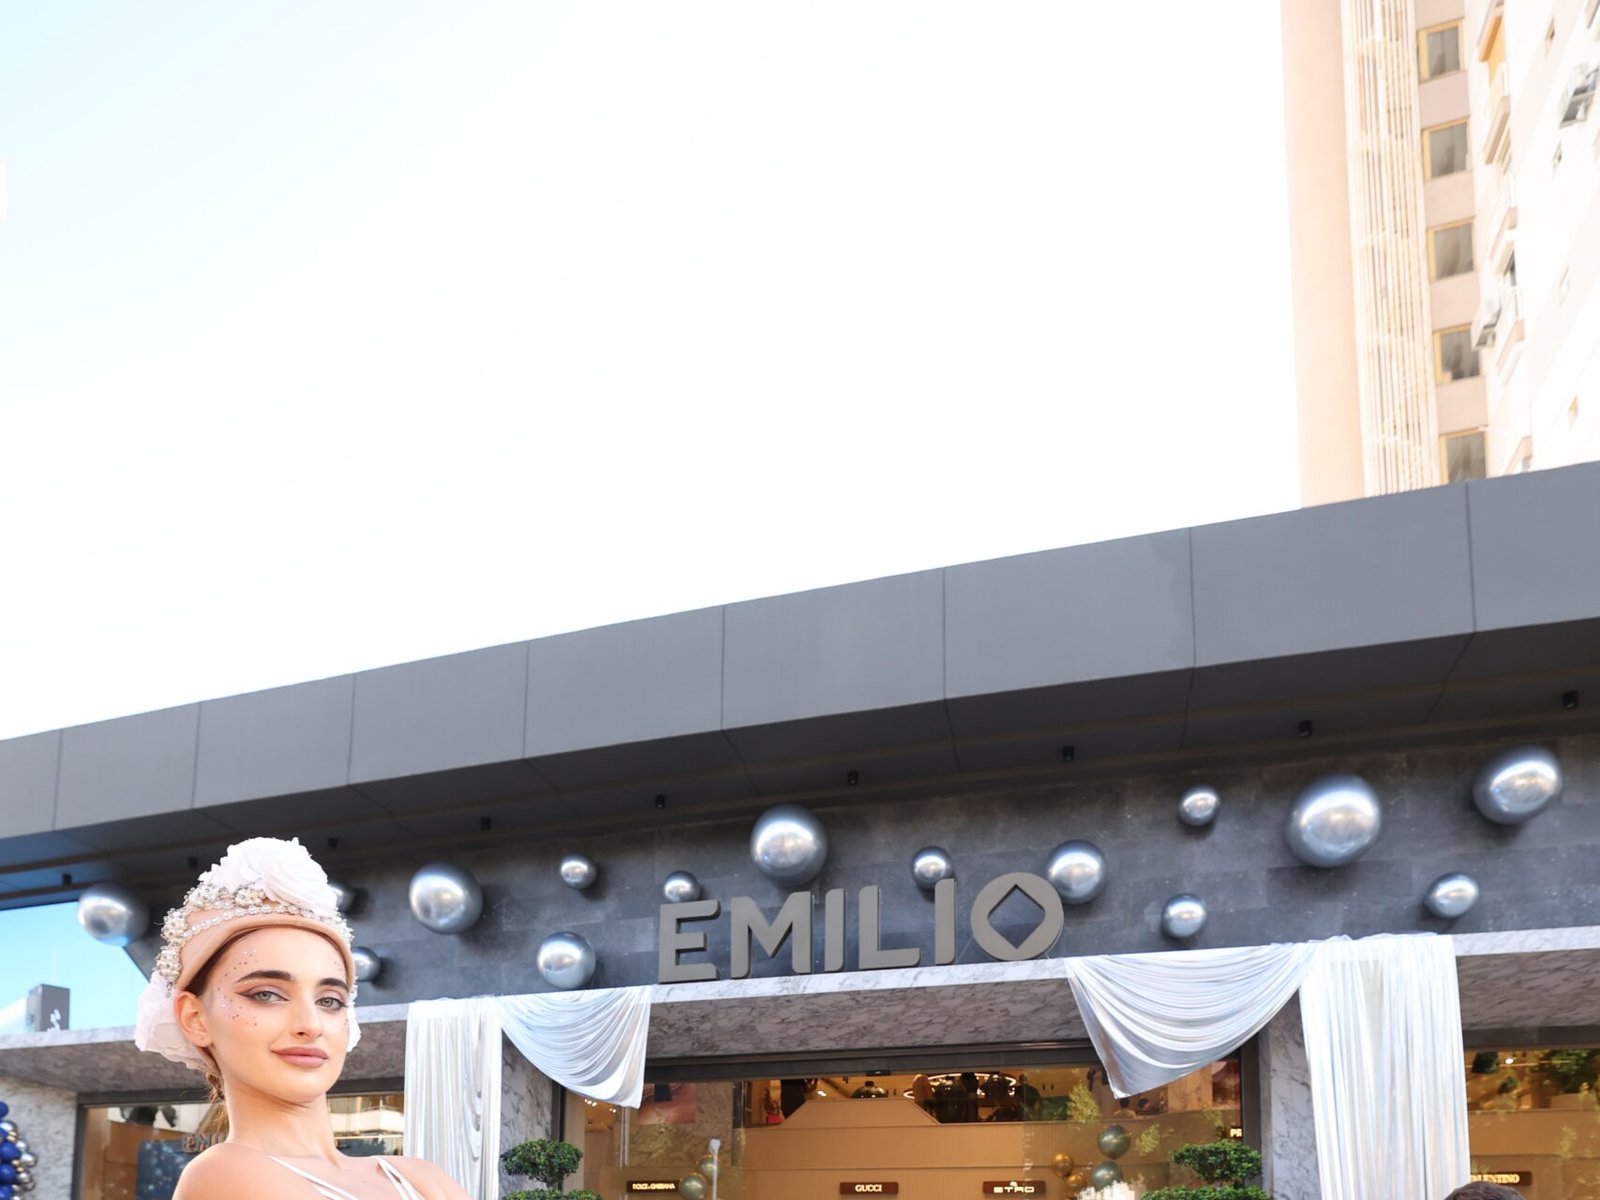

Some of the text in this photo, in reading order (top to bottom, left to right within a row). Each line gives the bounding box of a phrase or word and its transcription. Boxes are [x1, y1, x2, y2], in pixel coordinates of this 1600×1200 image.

[658, 872, 1065, 983] EMILIO
[855, 1184, 882, 1192] GUCCI
[993, 1186, 1035, 1194] ETRO
